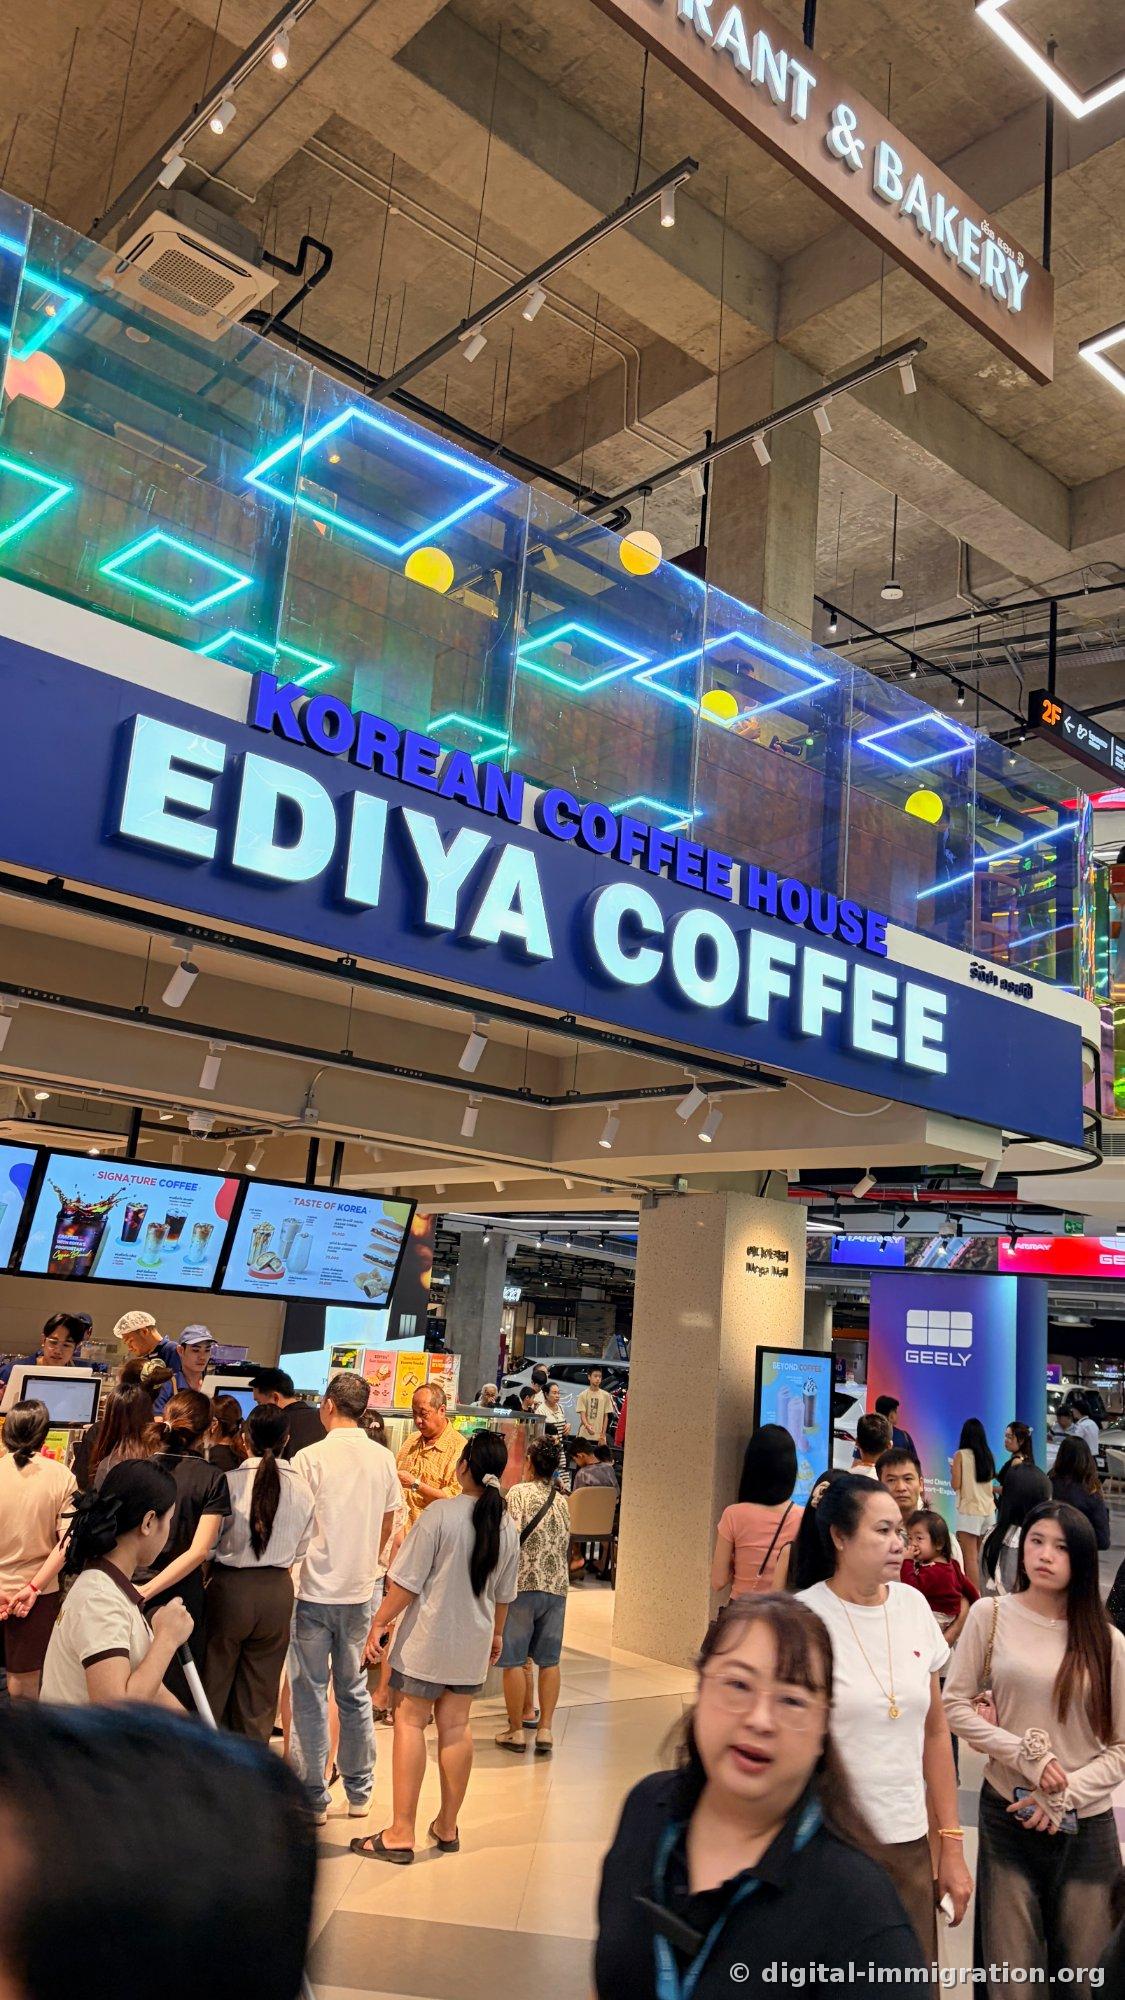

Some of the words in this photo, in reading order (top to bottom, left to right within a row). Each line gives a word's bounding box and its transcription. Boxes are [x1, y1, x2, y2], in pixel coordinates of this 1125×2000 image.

[826, 103, 865, 171] &
[873, 140, 1030, 314] BAKERY
[1041, 699, 1062, 726] 2F
[250, 670, 525, 824] KOREAN
[534, 787, 734, 900] COFFEE
[748, 864, 888, 957] HOUSE
[117, 712, 554, 960] EDIYA
[592, 881, 948, 1075] COFFEE
[97, 1171, 158, 1186] SIGNATURE
[158, 1178, 199, 1192] COFFEE
[293, 1197, 322, 1209] TASTE
[323, 1201, 337, 1210] OF
[337, 1204, 367, 1214] KOREA
[772, 1361, 799, 1371] BEYOND
[905, 1350, 972, 1367] GEELY
